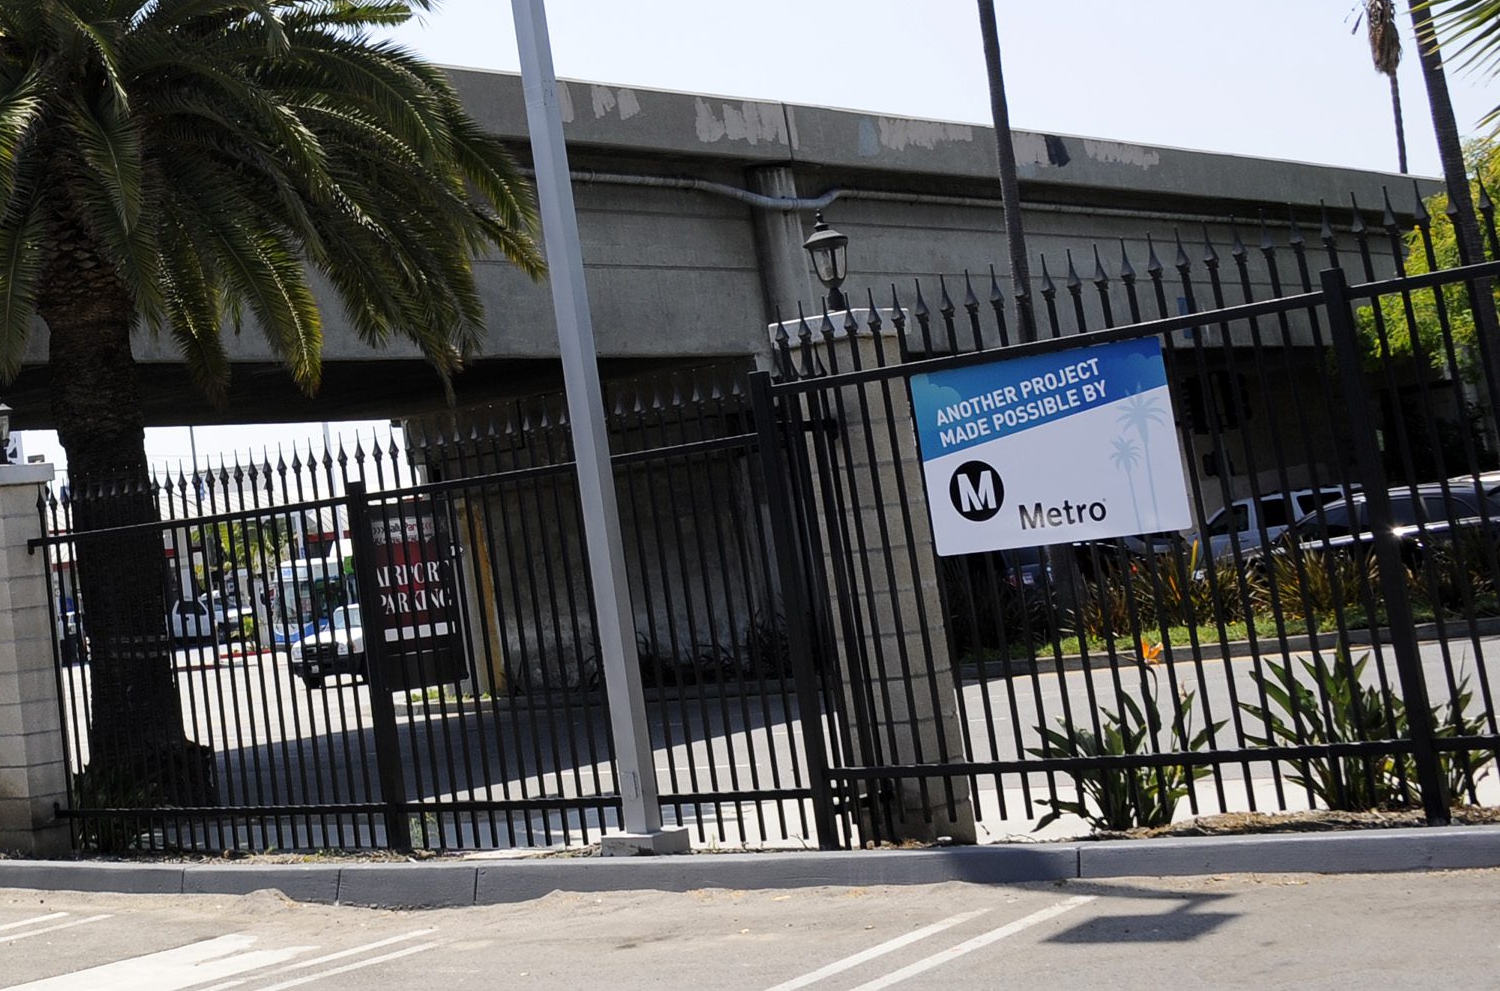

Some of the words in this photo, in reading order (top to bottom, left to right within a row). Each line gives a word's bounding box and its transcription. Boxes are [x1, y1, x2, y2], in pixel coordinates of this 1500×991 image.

[937, 386, 1017, 426] ANOTHER
[1020, 358, 1100, 397] PROJECT
[939, 420, 991, 448] MADE
[995, 394, 1080, 431] POSSIBLE
[1083, 380, 1107, 403] BY
[957, 470, 997, 513] M
[1018, 500, 1107, 530] Metro
